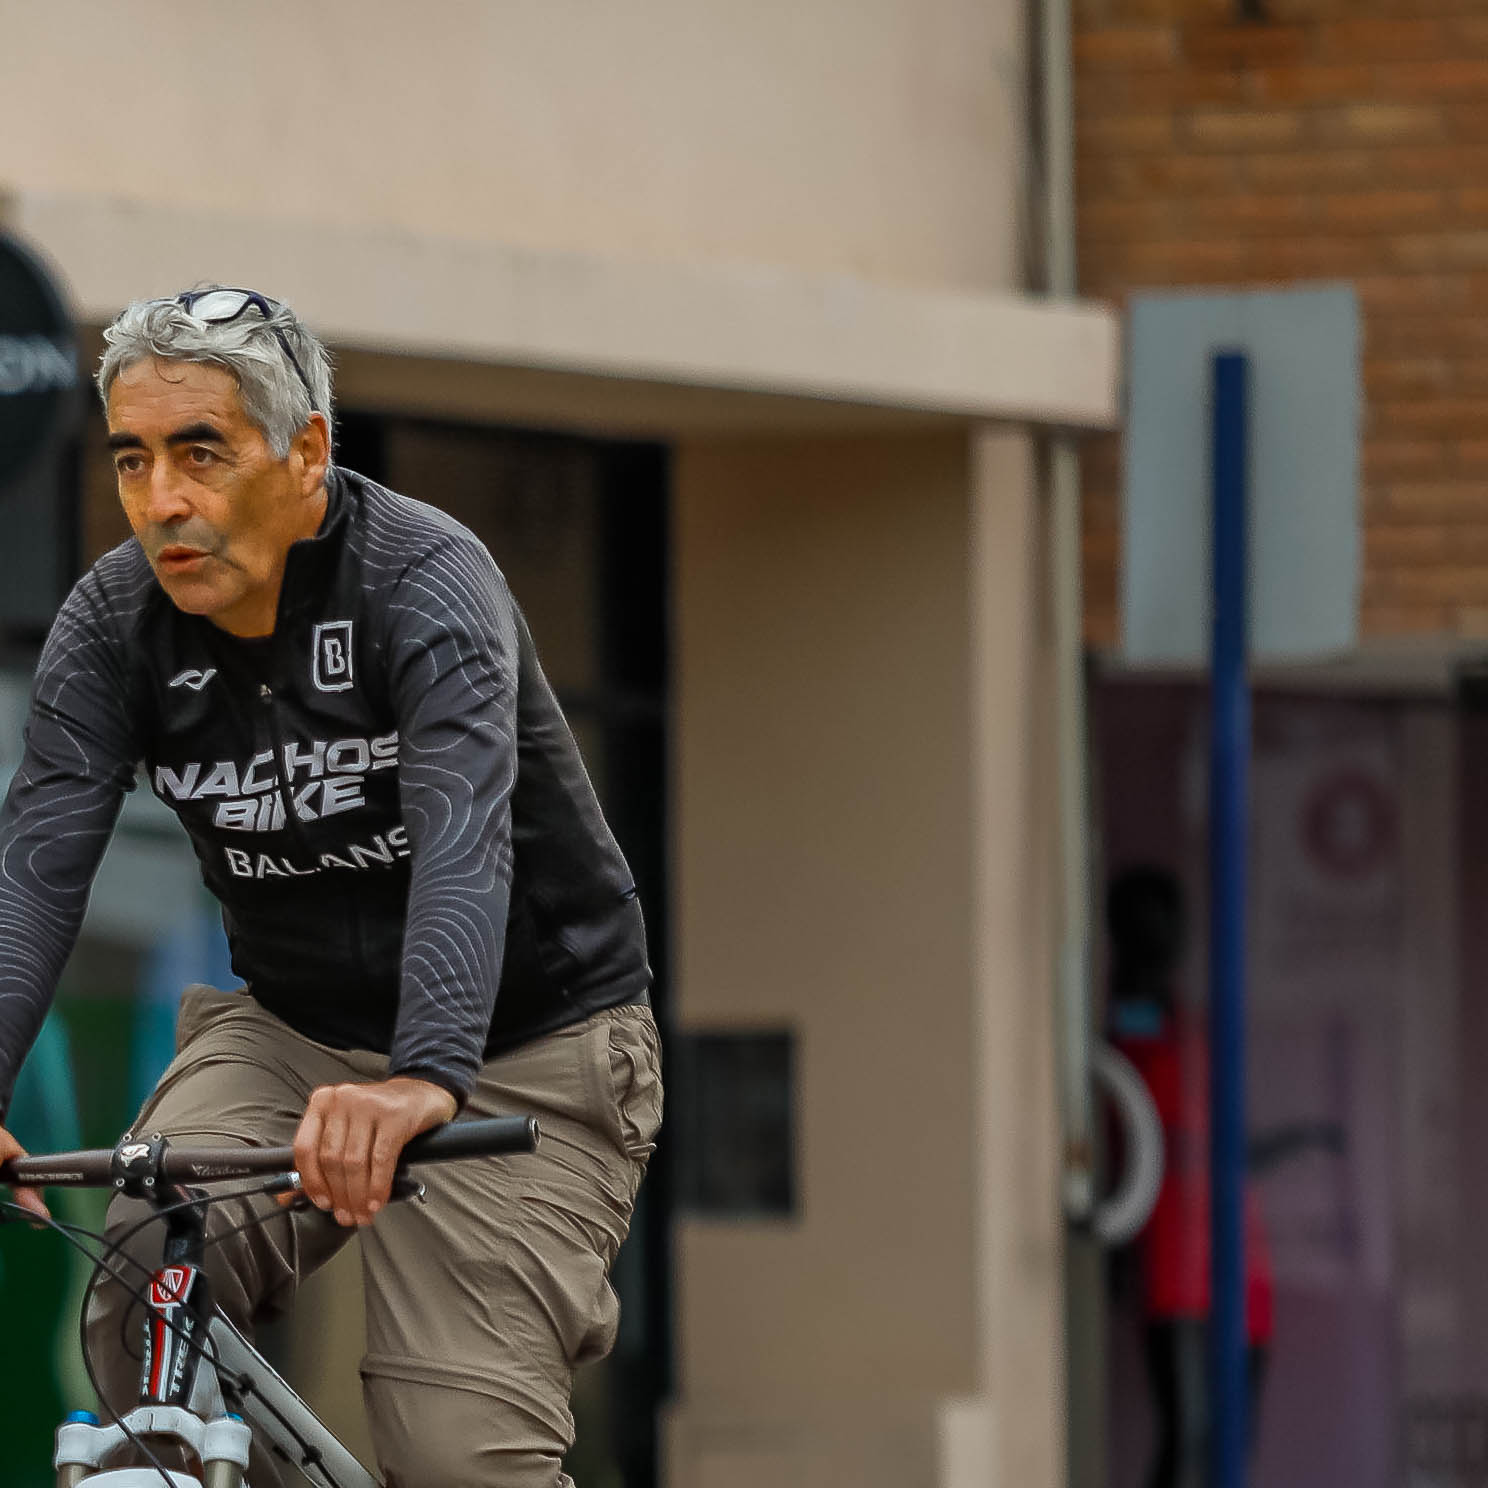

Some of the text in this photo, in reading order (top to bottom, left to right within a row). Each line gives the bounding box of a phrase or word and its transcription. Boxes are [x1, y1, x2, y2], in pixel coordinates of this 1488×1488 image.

[325, 638, 346, 675] B
[156, 731, 399, 800] NACHOS
[215, 776, 366, 831] BIKE
